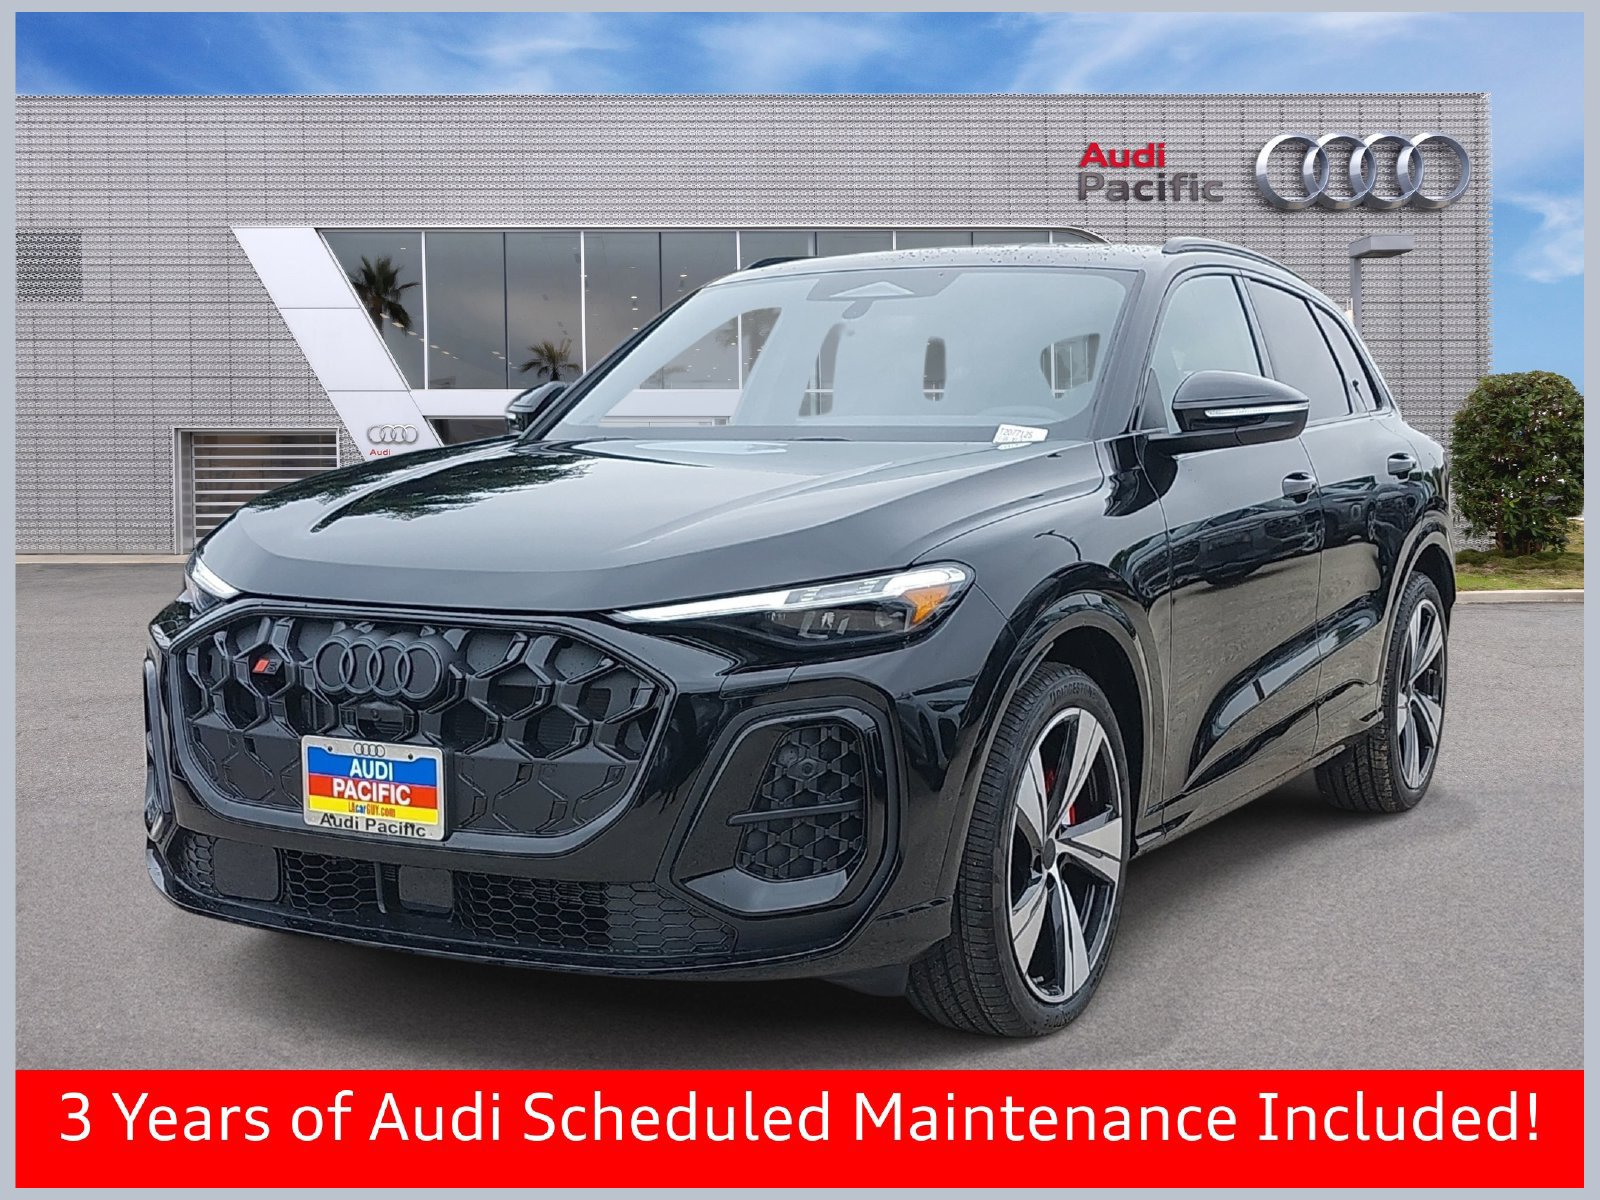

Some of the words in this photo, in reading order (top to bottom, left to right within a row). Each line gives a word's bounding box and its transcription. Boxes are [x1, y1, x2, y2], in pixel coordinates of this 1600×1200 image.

[1079, 142, 1165, 168] Audi
[1078, 172, 1223, 203] Pacific
[349, 758, 394, 781] AUDI
[332, 777, 411, 805] PACIFIC
[319, 812, 359, 830] Audi
[365, 817, 426, 838] Pacific
